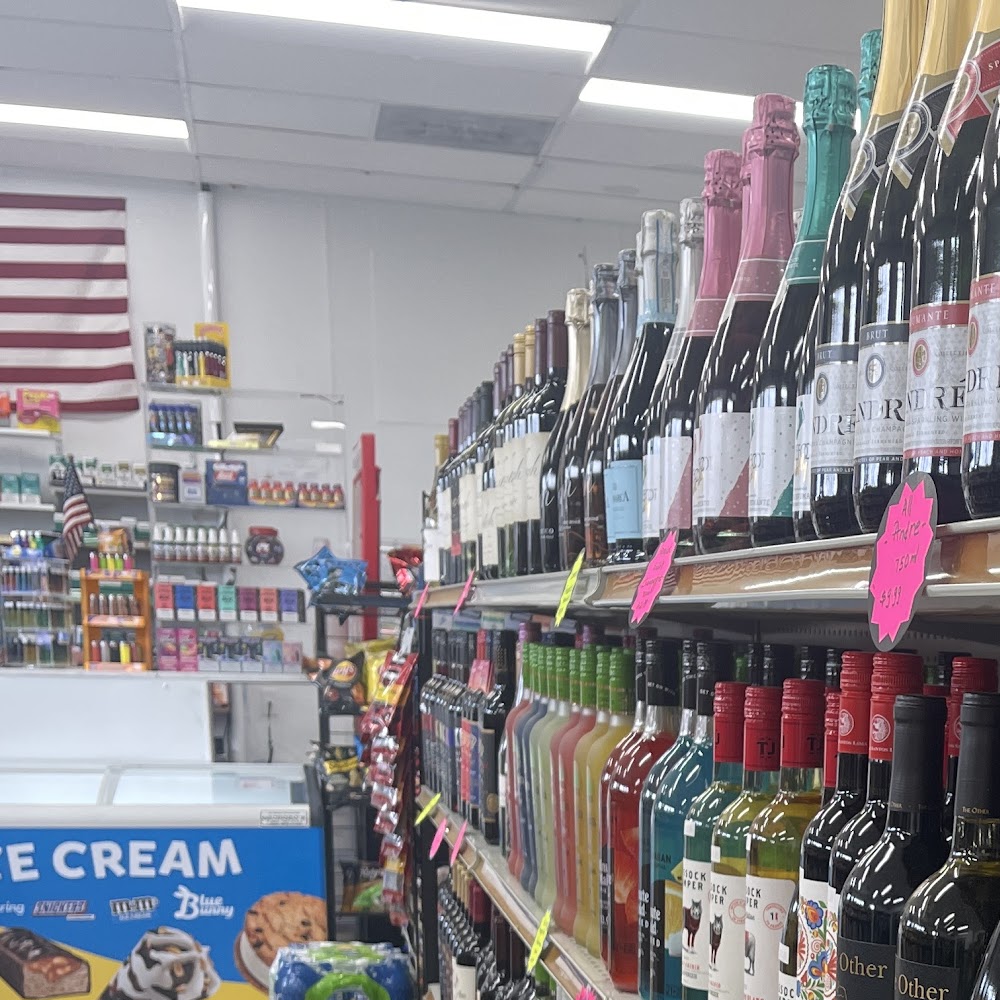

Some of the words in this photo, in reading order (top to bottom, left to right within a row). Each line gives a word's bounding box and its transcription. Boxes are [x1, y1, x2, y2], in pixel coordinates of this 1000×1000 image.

[866, 329, 888, 341] BRUT
[52, 837, 243, 880] CREAM
[0, 900, 25, 916] ring
[839, 952, 888, 979] Other
